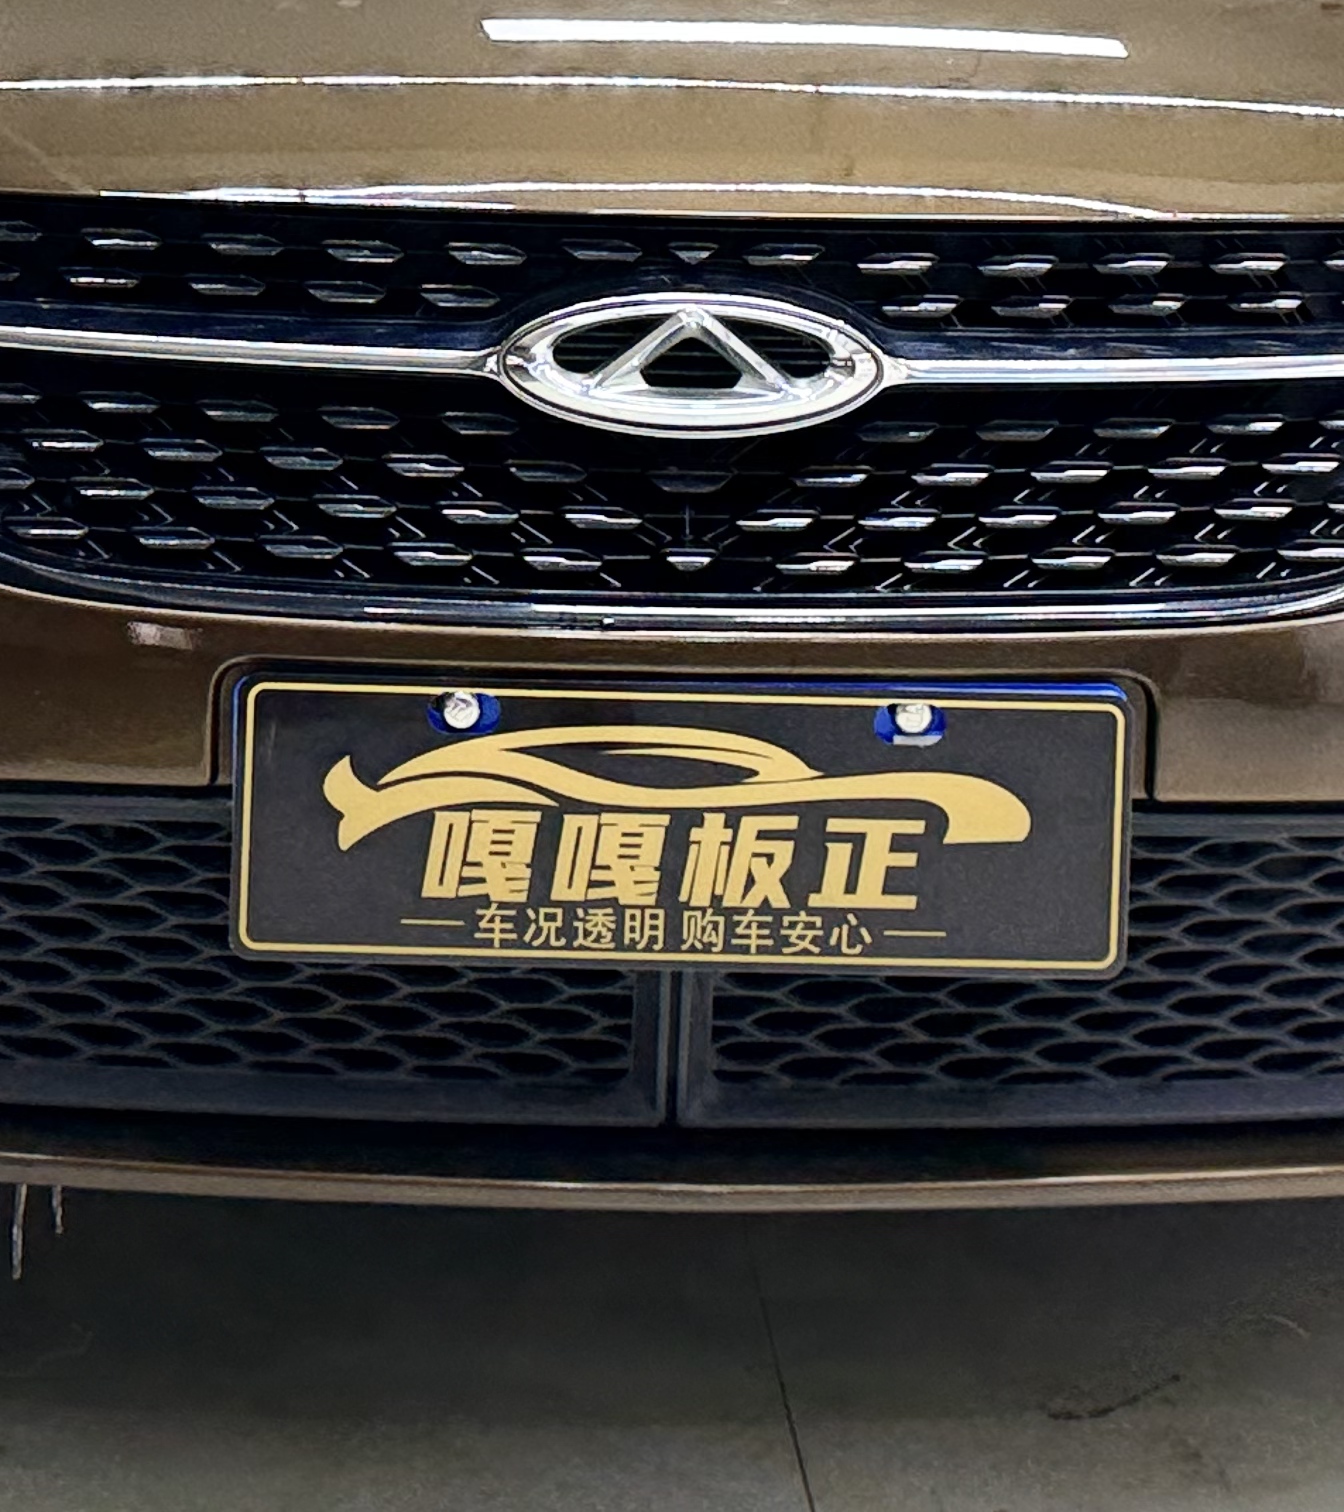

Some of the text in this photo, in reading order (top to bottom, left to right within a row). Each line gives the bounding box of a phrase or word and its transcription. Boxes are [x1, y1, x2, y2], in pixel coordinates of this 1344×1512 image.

[420, 809, 927, 911] 嘎嘎板正
[474, 904, 873, 955] 车况透明 购车安心
